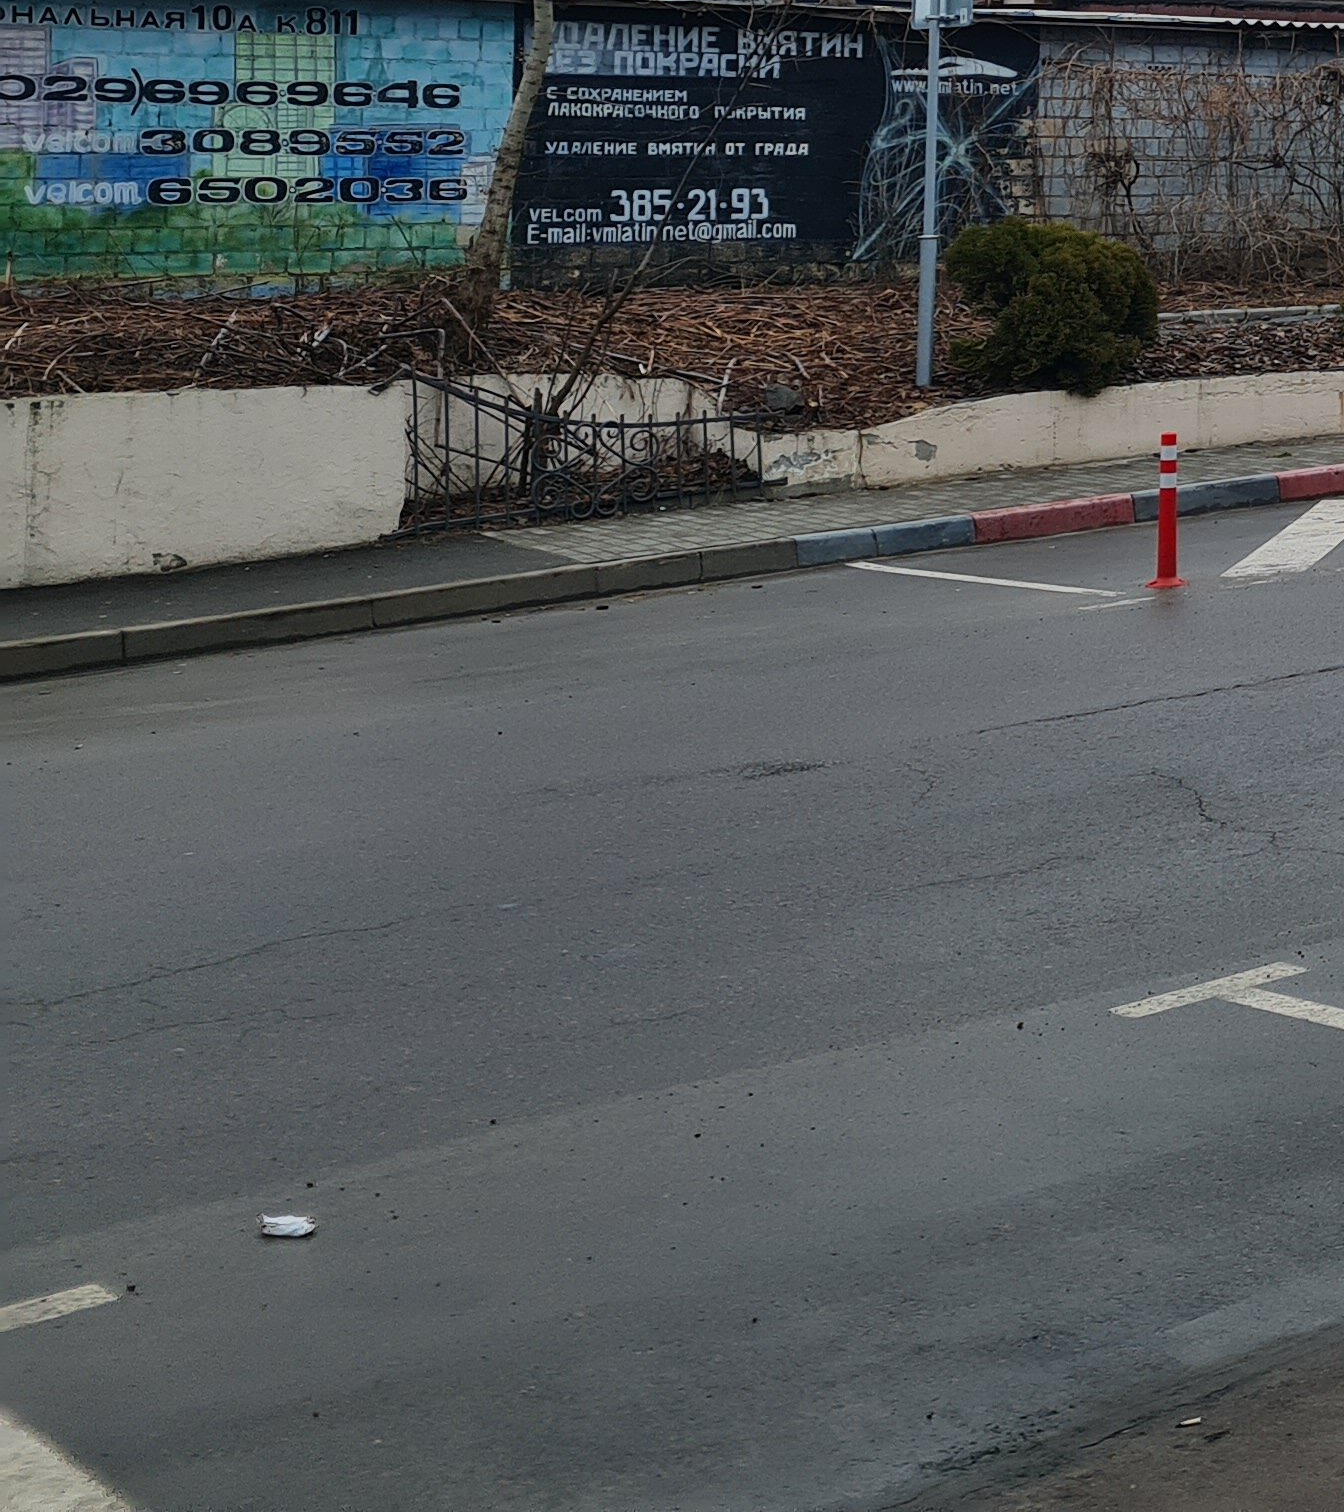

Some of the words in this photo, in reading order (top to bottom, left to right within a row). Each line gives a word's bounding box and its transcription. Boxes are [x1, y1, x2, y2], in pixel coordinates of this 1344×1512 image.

[0, 4, 187, 30] НАЛЬНАЯ
[546, 86, 558, 100] С
[566, 86, 688, 102] СОХРАНЕНИЕМ
[547, 102, 700, 120] ЛАКОКРАСОЧНОГО
[544, 141, 638, 155] УДАЛЕНИЕ
[725, 142, 745, 156] ОТ
[755, 143, 809, 156] ГРАДА
[24, 181, 141, 205] velcom
